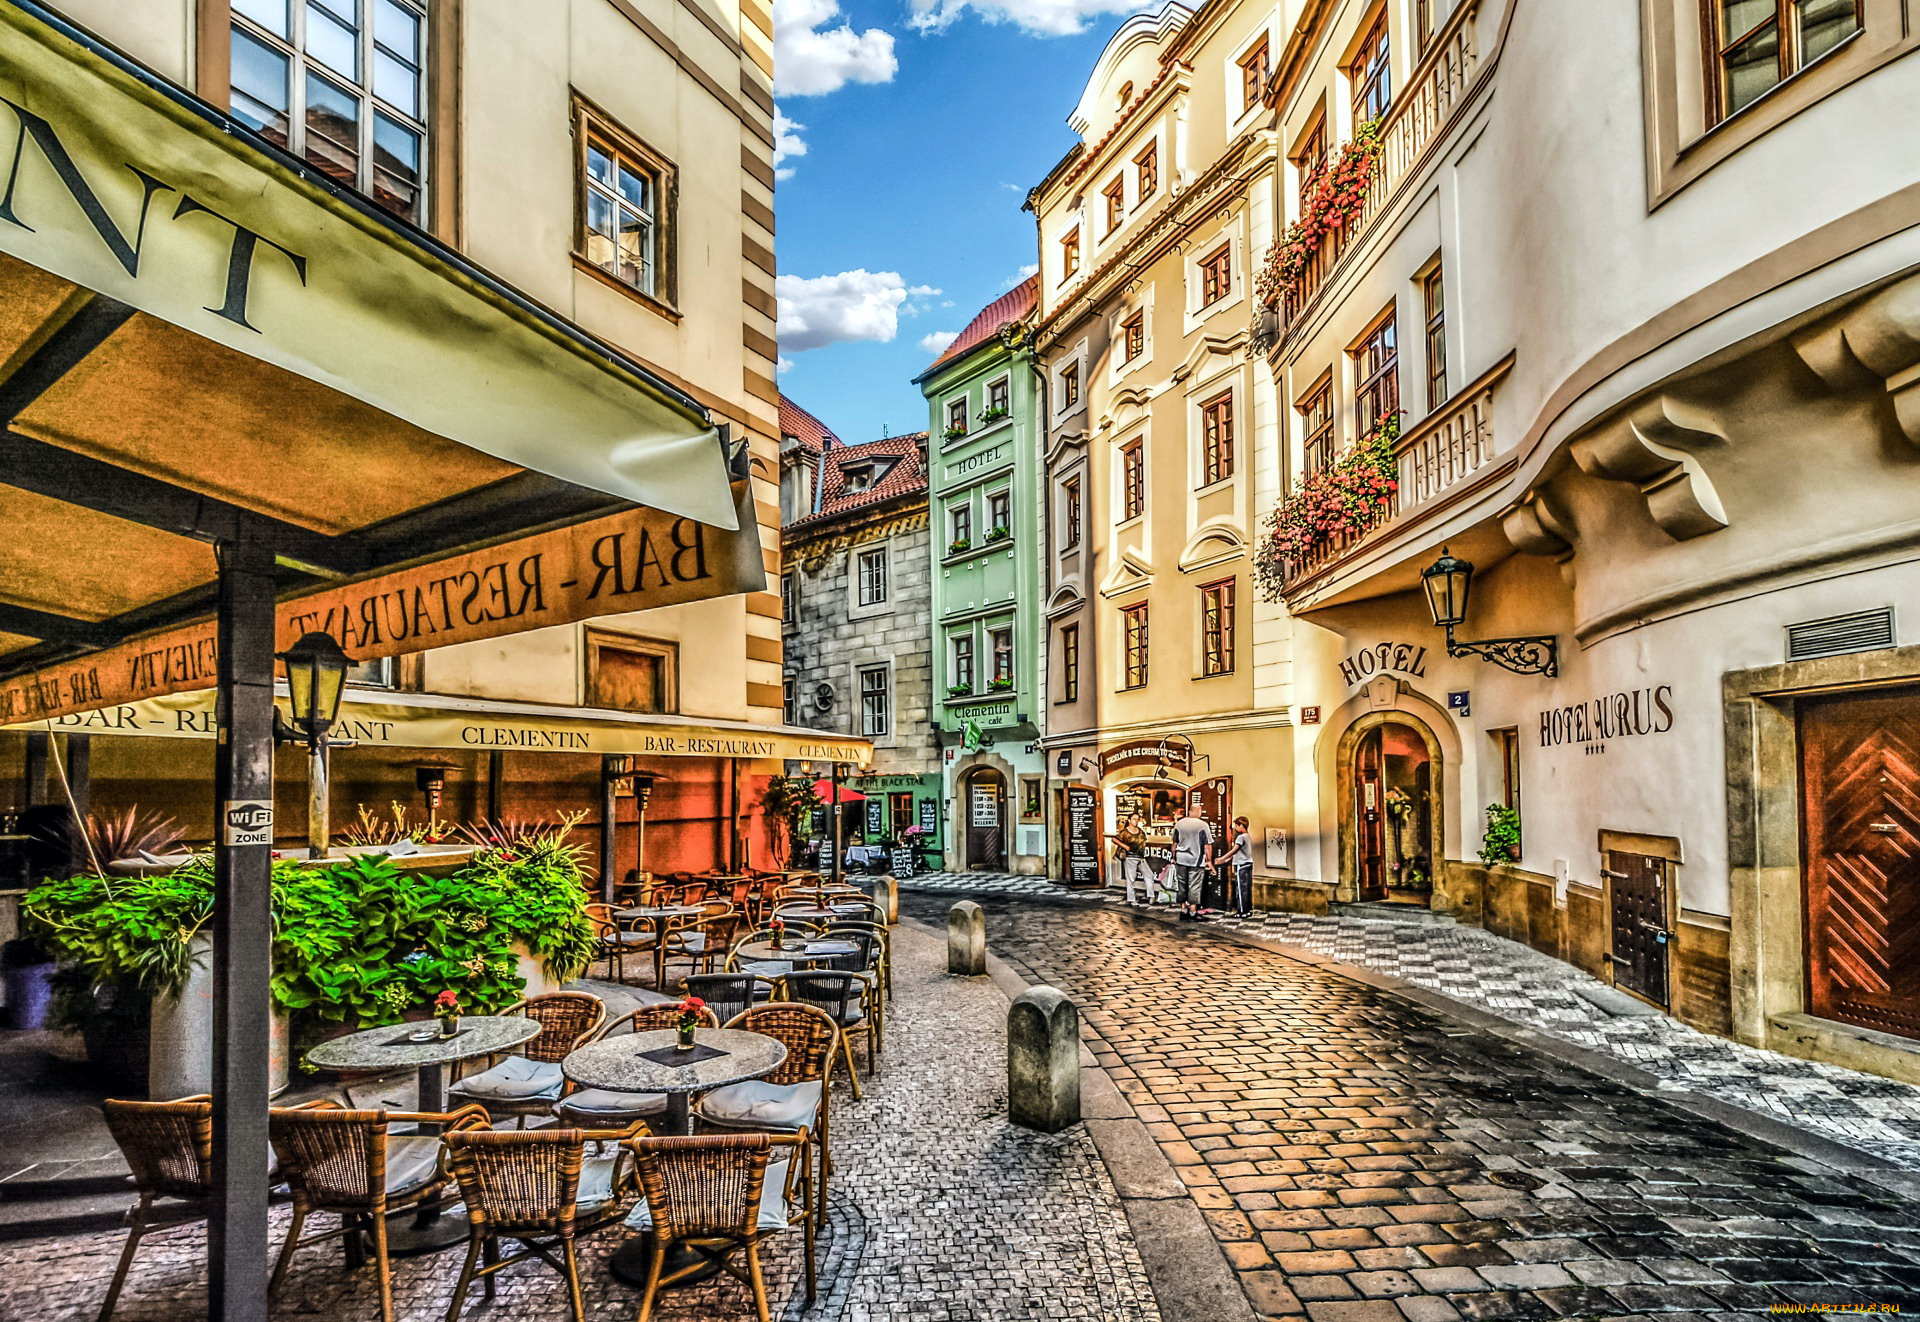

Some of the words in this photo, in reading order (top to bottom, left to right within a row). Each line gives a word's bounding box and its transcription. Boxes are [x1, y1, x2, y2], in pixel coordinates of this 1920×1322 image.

[957, 446, 1002, 475] HOTEL
[1337, 640, 1430, 688] HOTEL
[1454, 695, 1462, 705] 2
[954, 703, 1010, 719] Clementin
[1304, 708, 1316, 716] 175
[1539, 701, 1591, 748] HOTEL
[1593, 684, 1674, 740] AURUS
[461, 726, 590, 749] CLEMENTIN
[644, 736, 676, 752] BAR
[688, 738, 776, 756] RESTAURANT
[799, 744, 861, 760] CLEMENTIN
[1132, 748, 1141, 756] ICE
[1141, 747, 1160, 756] CREAM
[855, 778, 863, 787] AT
[866, 778, 878, 787] THE
[881, 778, 904, 787] BLACK
[906, 777, 925, 786] STAR
[235, 833, 267, 843] ZONE
[1150, 846, 1162, 858] ICE
